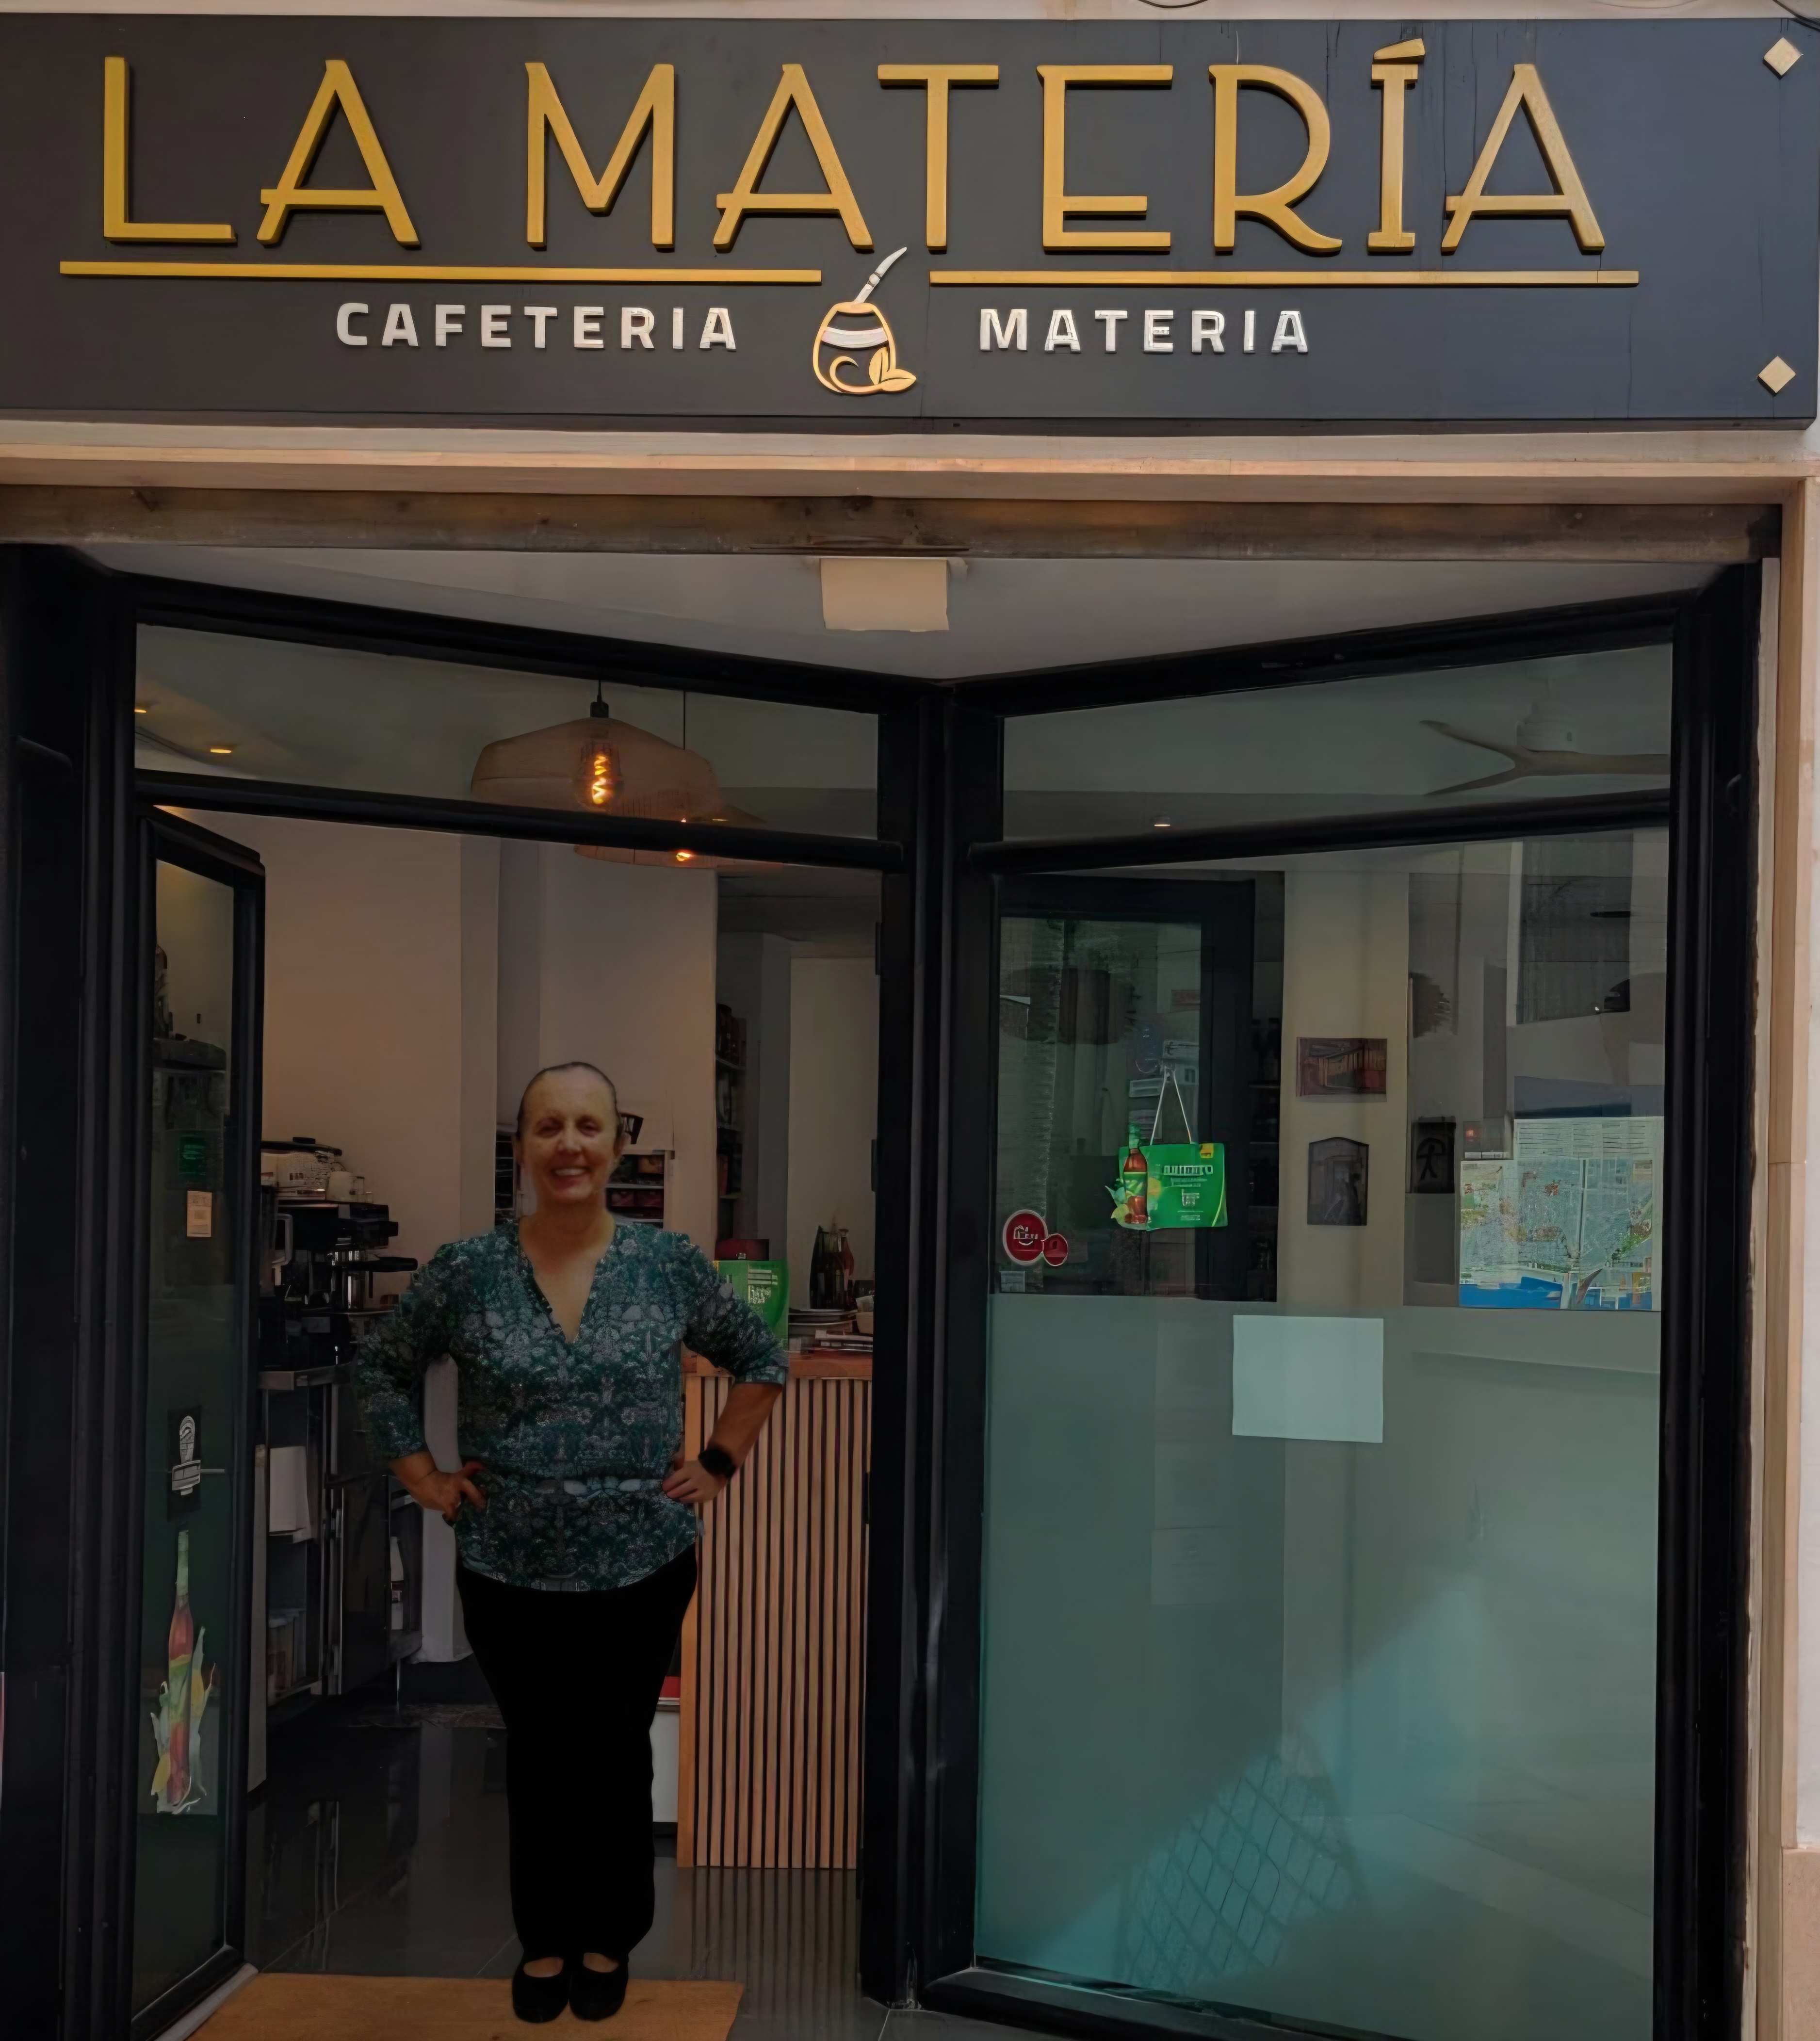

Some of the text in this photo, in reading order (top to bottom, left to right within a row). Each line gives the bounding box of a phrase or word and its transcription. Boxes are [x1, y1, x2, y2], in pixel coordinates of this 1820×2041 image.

[103, 38, 1606, 253] LA MATERÍA
[336, 302, 736, 351] CAFETERIA
[979, 308, 1309, 354] MATERIA
